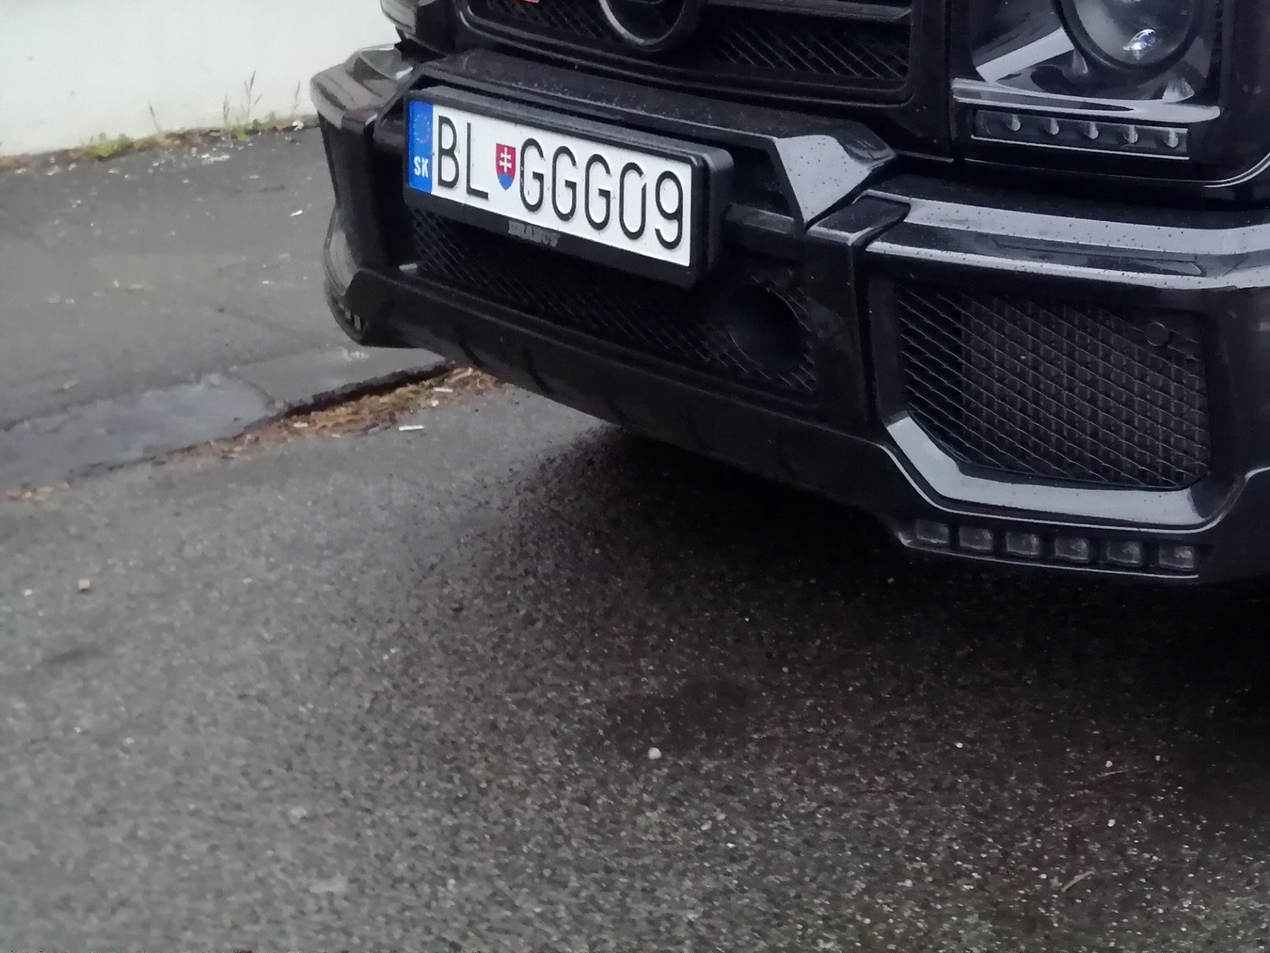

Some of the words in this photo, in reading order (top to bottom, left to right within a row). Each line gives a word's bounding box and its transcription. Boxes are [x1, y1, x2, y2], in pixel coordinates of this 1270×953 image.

[413, 155, 429, 179] SK
[437, 115, 490, 201] BL
[519, 137, 684, 251] GGG09
